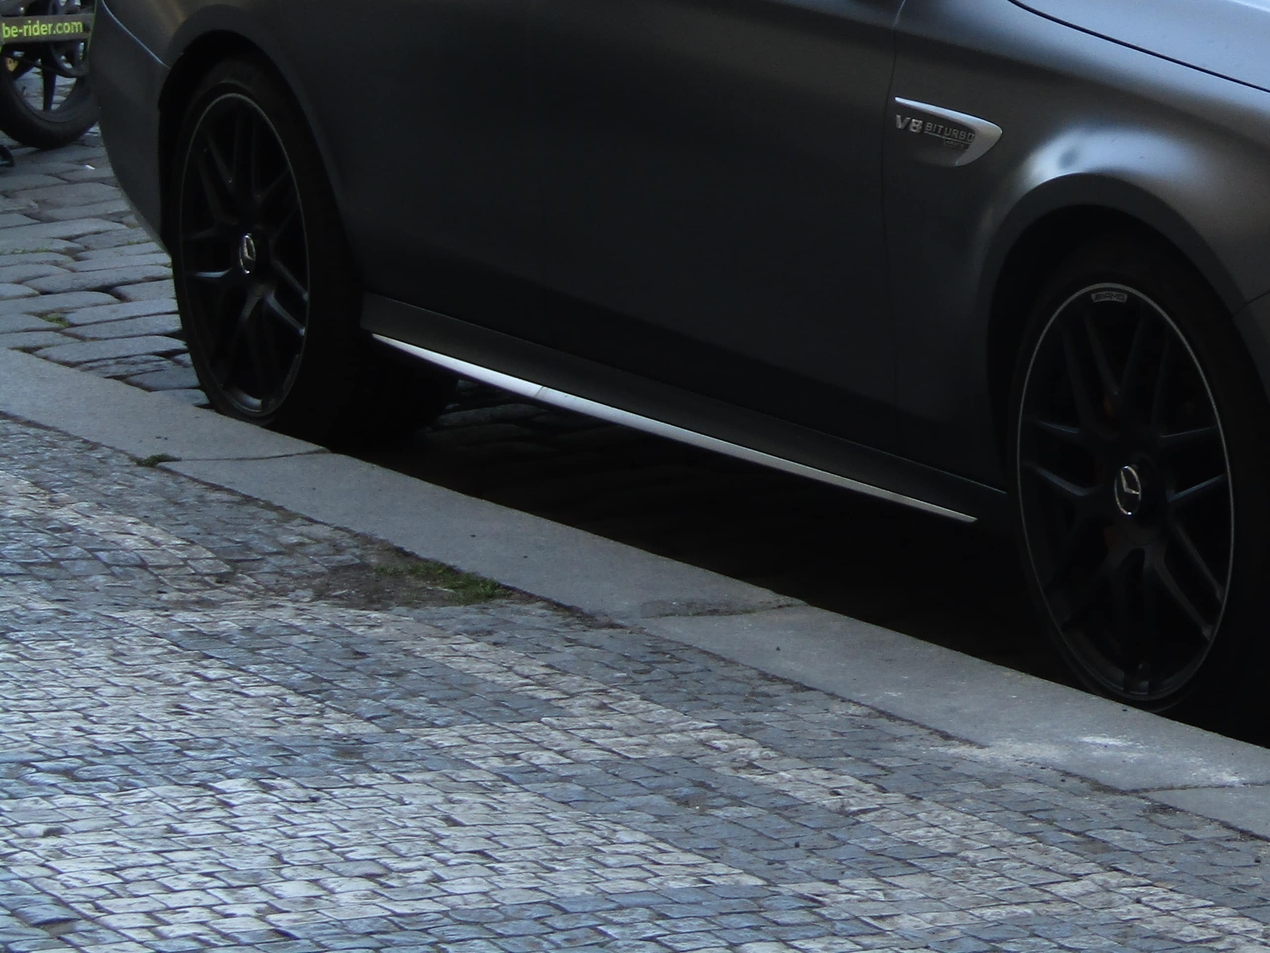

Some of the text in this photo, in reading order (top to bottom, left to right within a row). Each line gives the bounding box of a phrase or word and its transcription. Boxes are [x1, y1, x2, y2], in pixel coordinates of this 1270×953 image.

[2, 19, 83, 39] be-rider.com
[895, 114, 976, 142] V8 BITURBO
